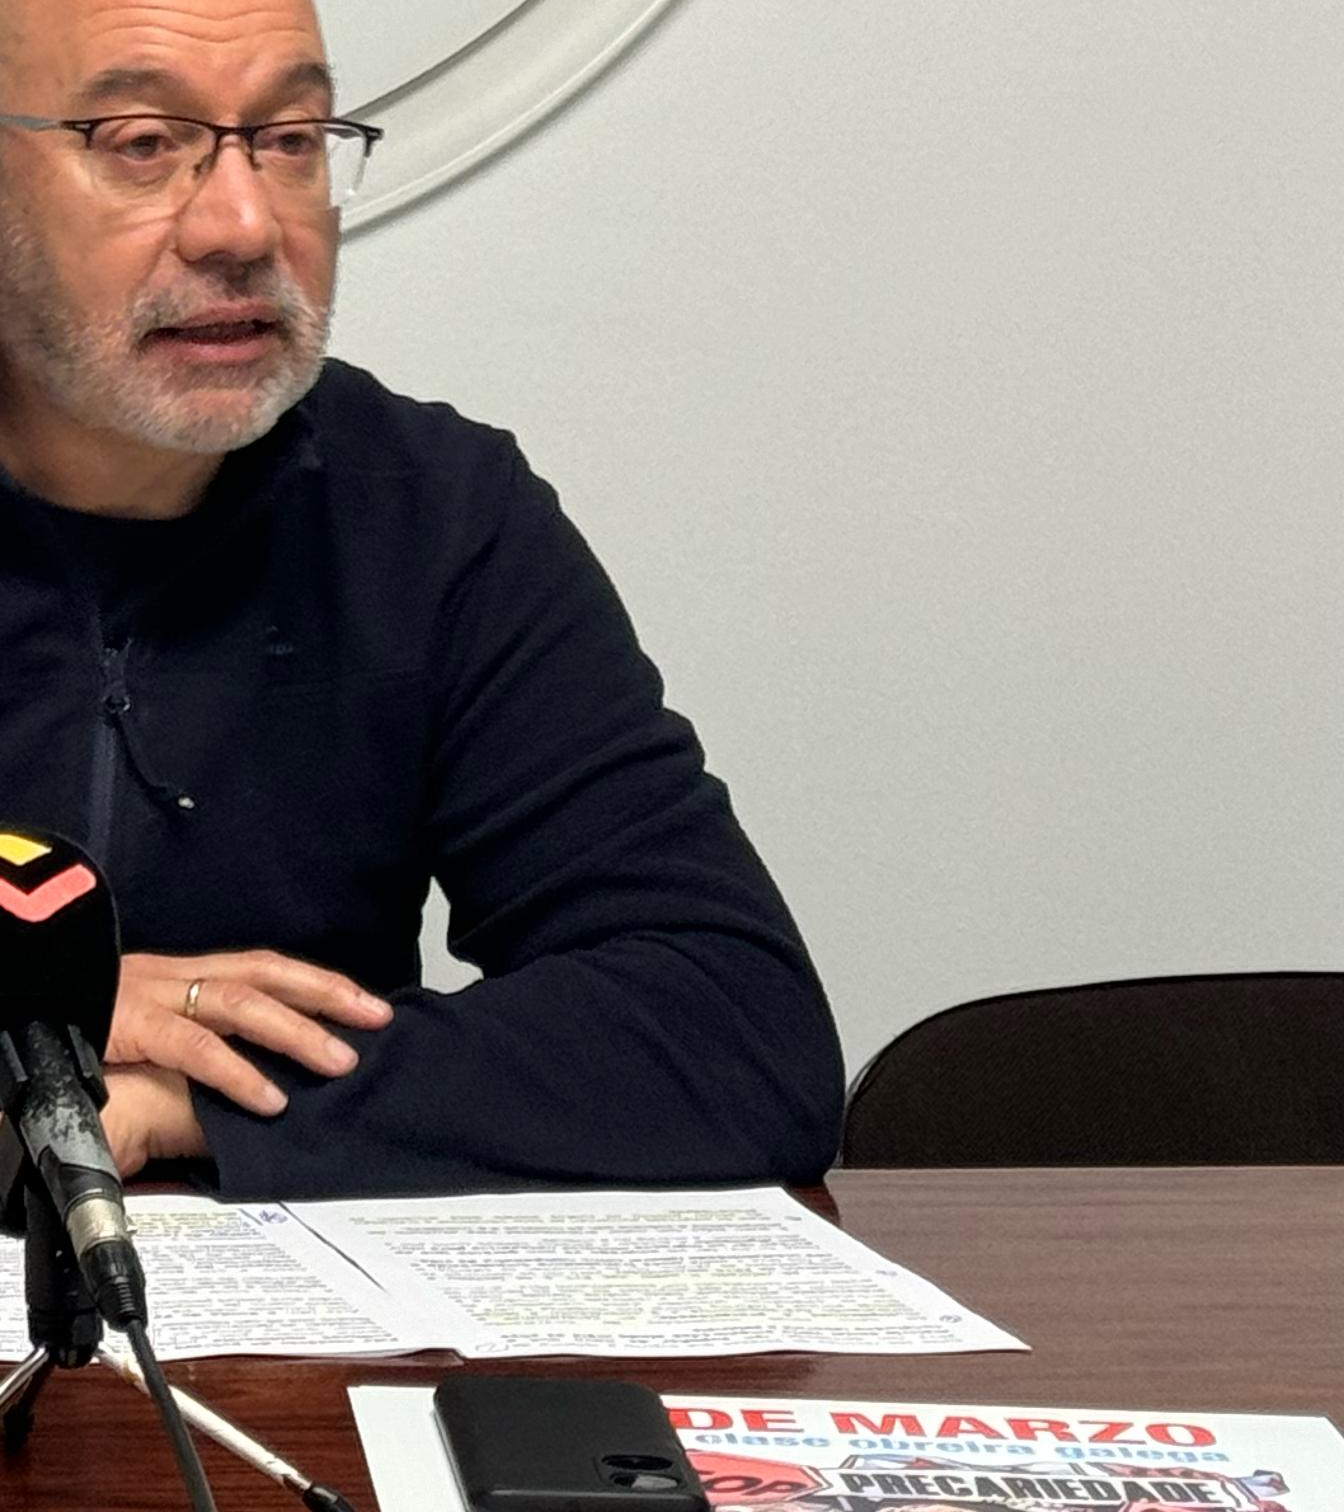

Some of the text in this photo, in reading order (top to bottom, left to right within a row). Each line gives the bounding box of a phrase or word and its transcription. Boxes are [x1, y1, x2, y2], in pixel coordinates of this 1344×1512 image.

[666, 1408, 1216, 1447] DE MARZO
[695, 1433, 1230, 1463] clase obreira galega
[839, 1473, 1223, 1503] PRECARIEDADE
